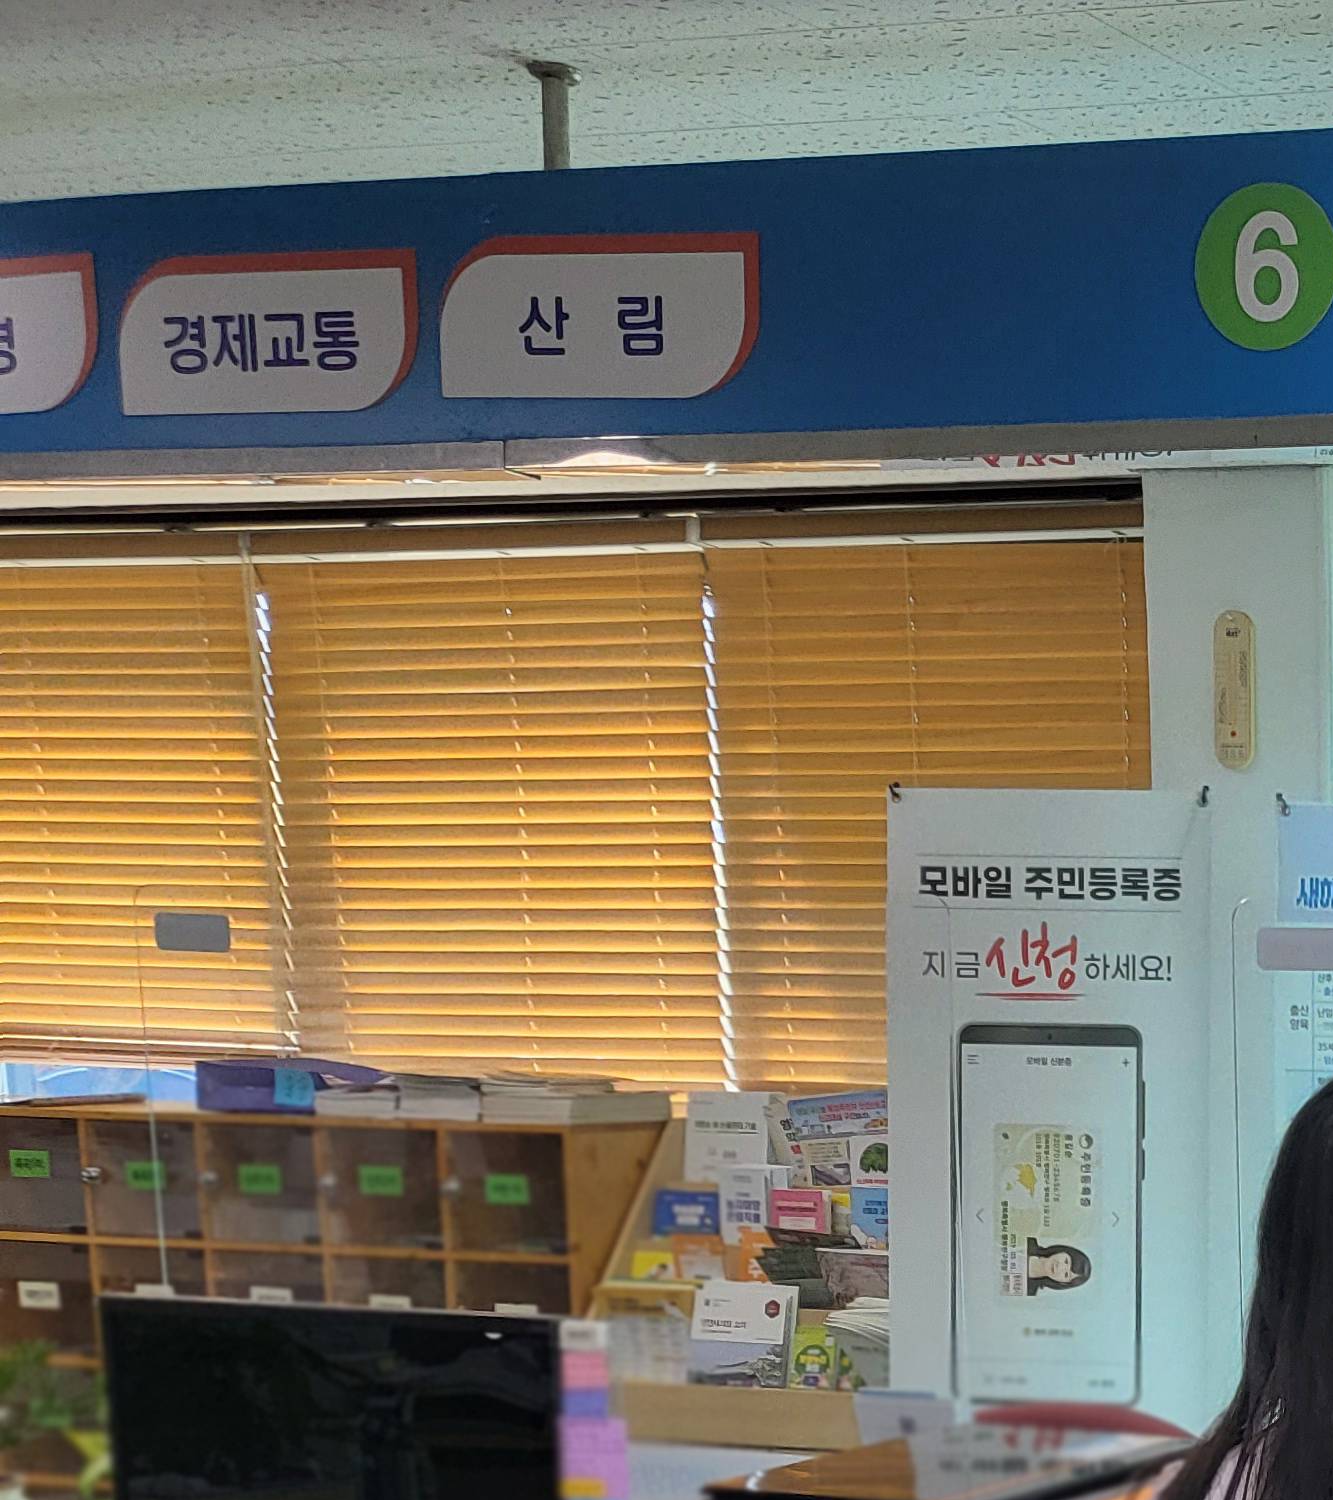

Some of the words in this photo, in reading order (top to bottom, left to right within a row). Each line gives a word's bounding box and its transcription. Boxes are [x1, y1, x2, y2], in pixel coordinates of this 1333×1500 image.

[1234, 211, 1299, 321] 6
[162, 310, 361, 375] 경제교통
[919, 865, 1012, 899] 모바일
[1024, 866, 1182, 901] 주민등록증
[922, 951, 980, 978] 지금
